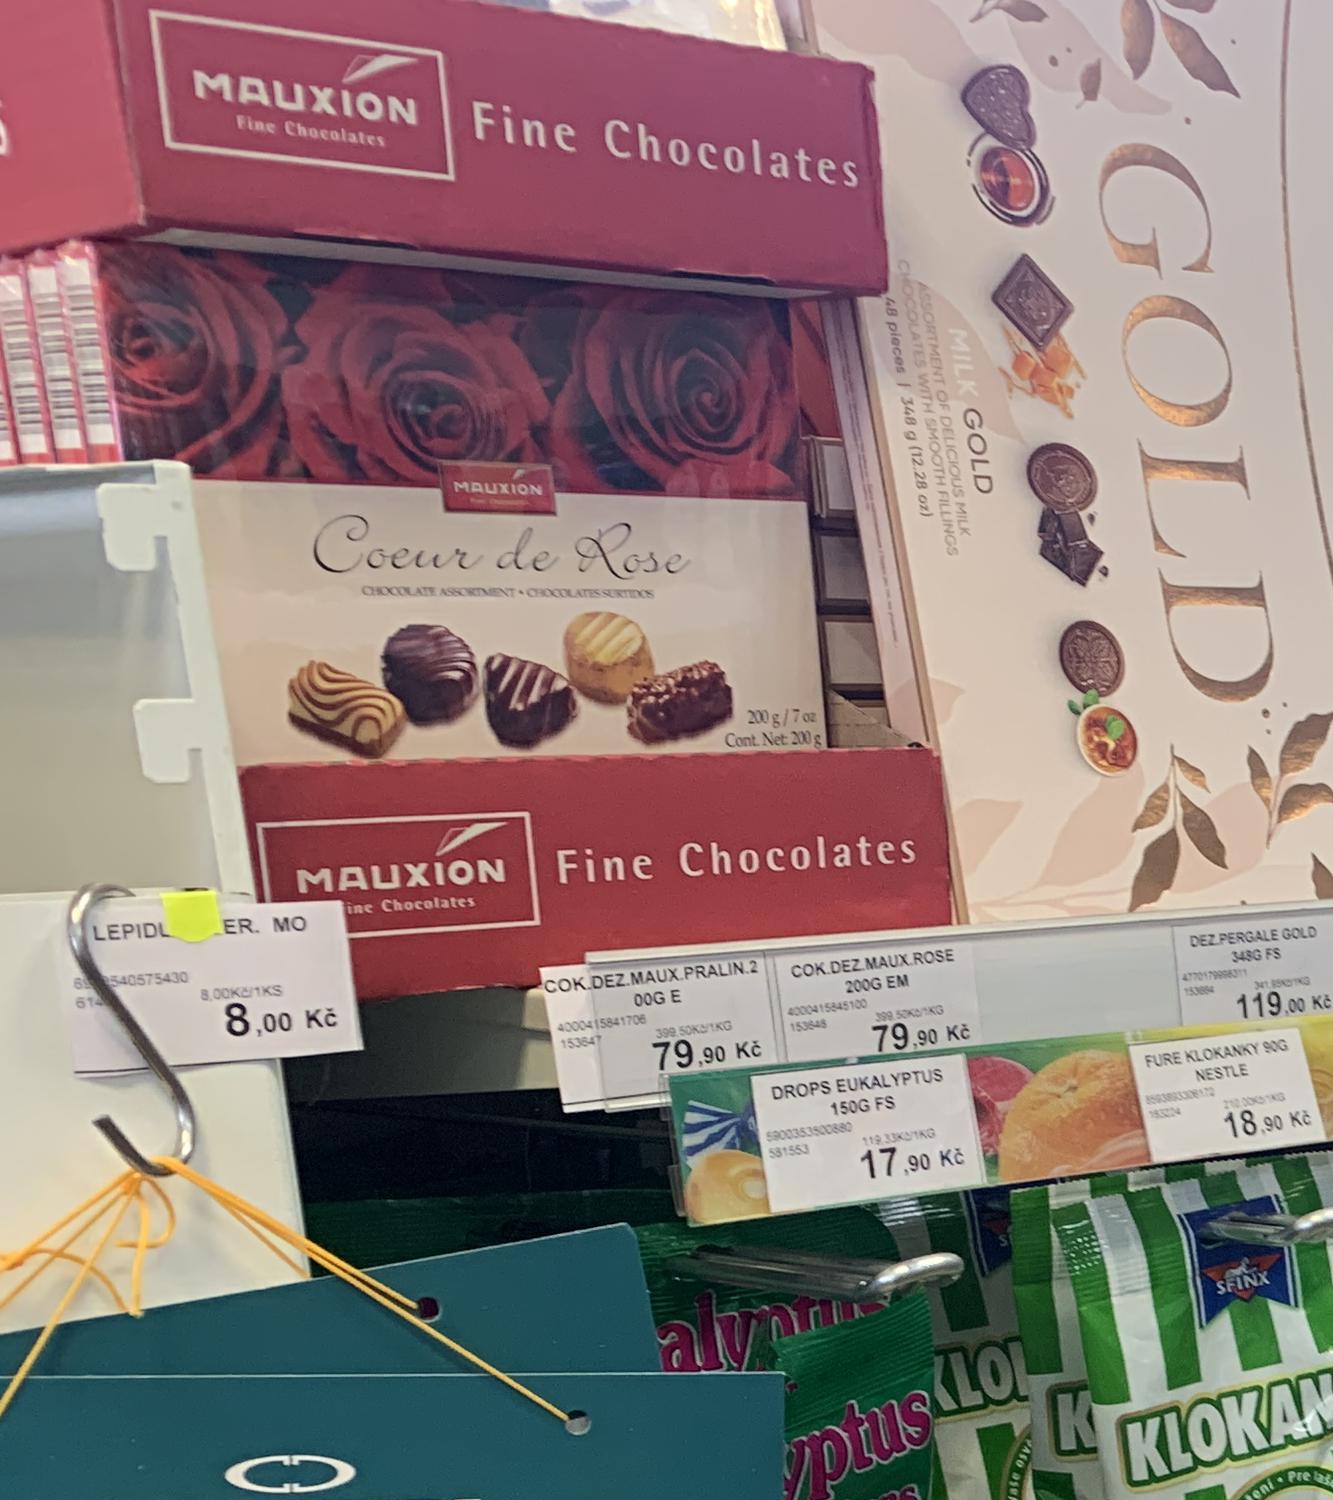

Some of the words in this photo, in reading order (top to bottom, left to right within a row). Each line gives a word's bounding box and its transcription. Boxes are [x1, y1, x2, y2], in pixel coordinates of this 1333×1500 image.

[193, 69, 418, 127] MAUXION
[236, 115, 274, 134] Fine
[284, 124, 387, 149] Chocolates
[473, 101, 577, 153] Fine
[605, 118, 859, 190] Chocolates
[949, 328, 978, 398] MILK
[1099, 142, 1274, 703] GOLD
[963, 408, 993, 495] GOLD
[454, 479, 544, 497] MAUXION
[313, 515, 485, 575] Coeur
[497, 545, 556, 573] de
[570, 523, 693, 575] Rose
[361, 586, 436, 598] CHOCOLATE
[440, 586, 514, 598] ASSORTMENT
[526, 586, 597, 599] CHOCOLATES
[600, 587, 654, 600] SURTIDOS
[556, 847, 653, 885] Fine
[678, 833, 917, 878] Chocolates
[297, 859, 506, 894] MAUXION
[1281, 925, 1317, 942] GOLD
[845, 976, 882, 994] 200G
[886, 973, 910, 990] EM
[1311, 994, 1332, 1011] Kč
[305, 1008, 337, 1029] Kč
[735, 1042, 762, 1059] Kč
[1145, 1050, 1181, 1068] FURE
[1185, 1041, 1261, 1064] KLOKANKY
[1264, 1038, 1289, 1056] 90G
[771, 1080, 831, 1102] DROPS
[836, 1069, 944, 1094] EUKALYPTUS
[1195, 1063, 1249, 1082] NESTLE
[830, 1098, 870, 1116] 150G
[874, 1095, 896, 1112] FS
[940, 1148, 965, 1166] Kč
